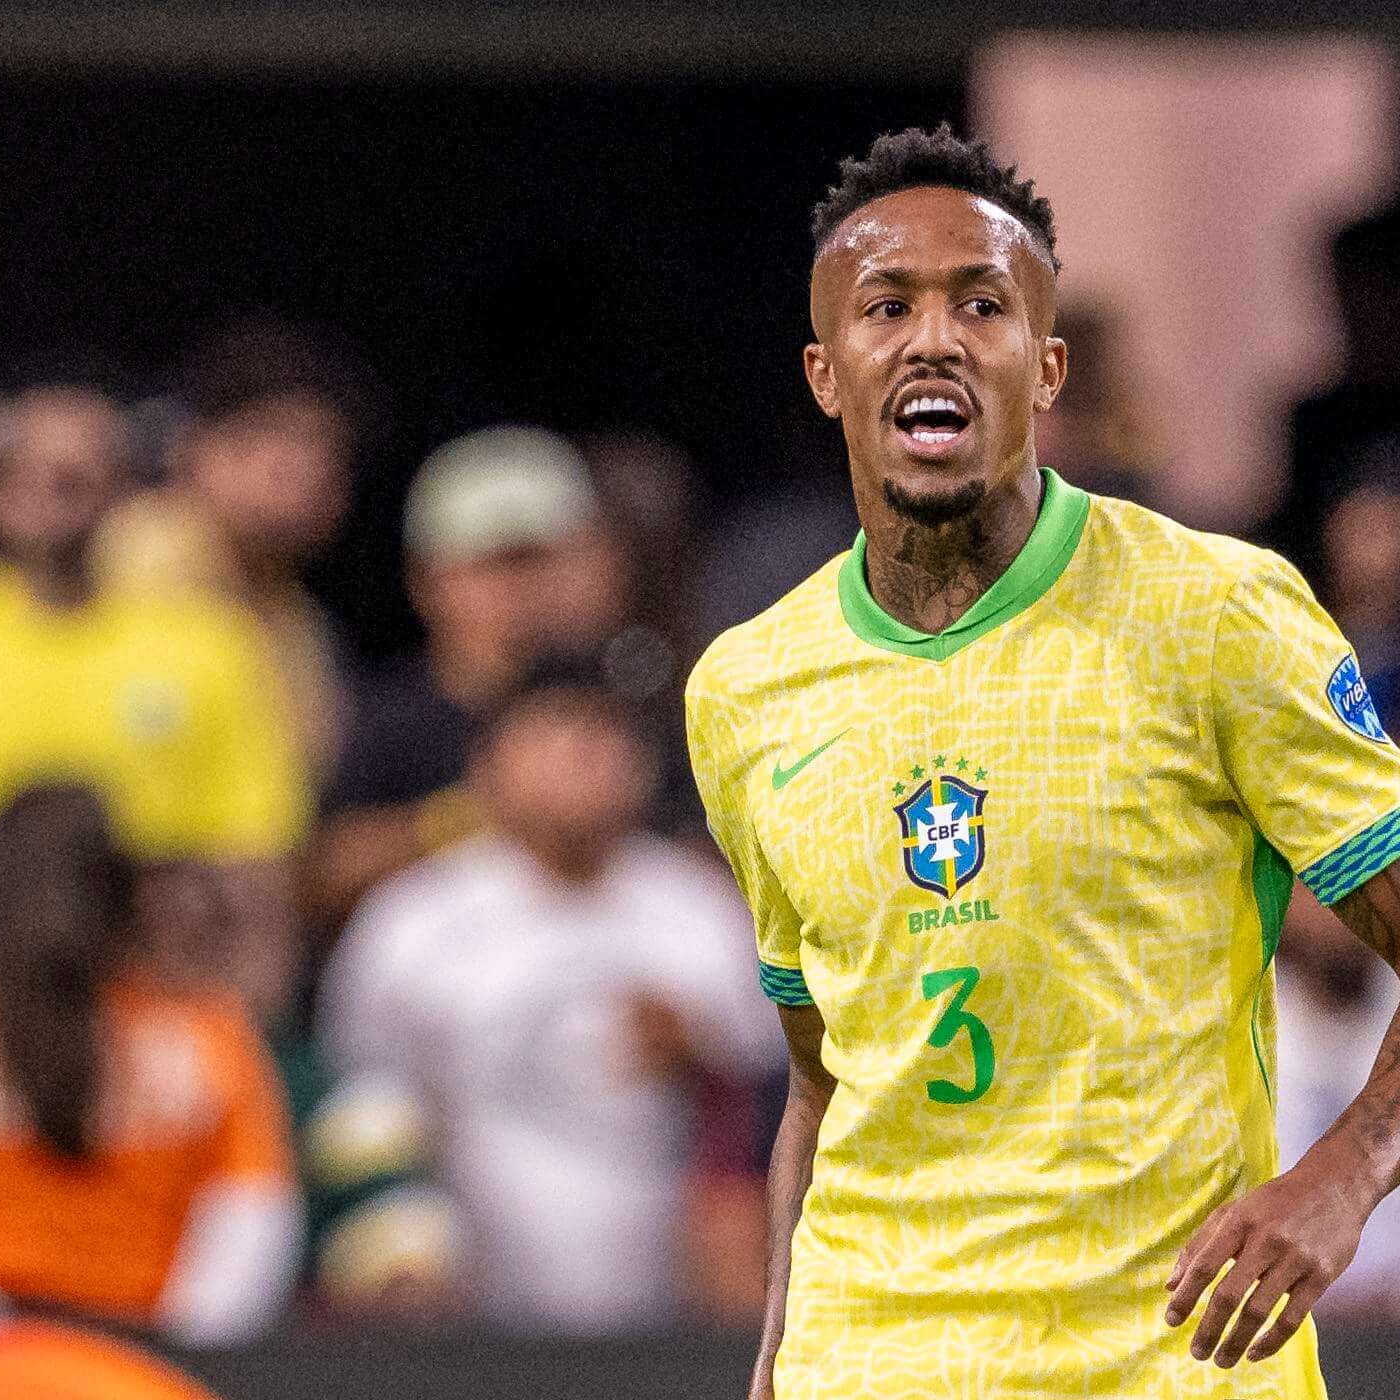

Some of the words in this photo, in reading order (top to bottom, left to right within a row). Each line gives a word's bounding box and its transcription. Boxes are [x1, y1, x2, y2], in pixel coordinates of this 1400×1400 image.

[927, 823, 960, 842] CBF
[908, 900, 1000, 935] BRASIL
[921, 966, 996, 1104] 3
